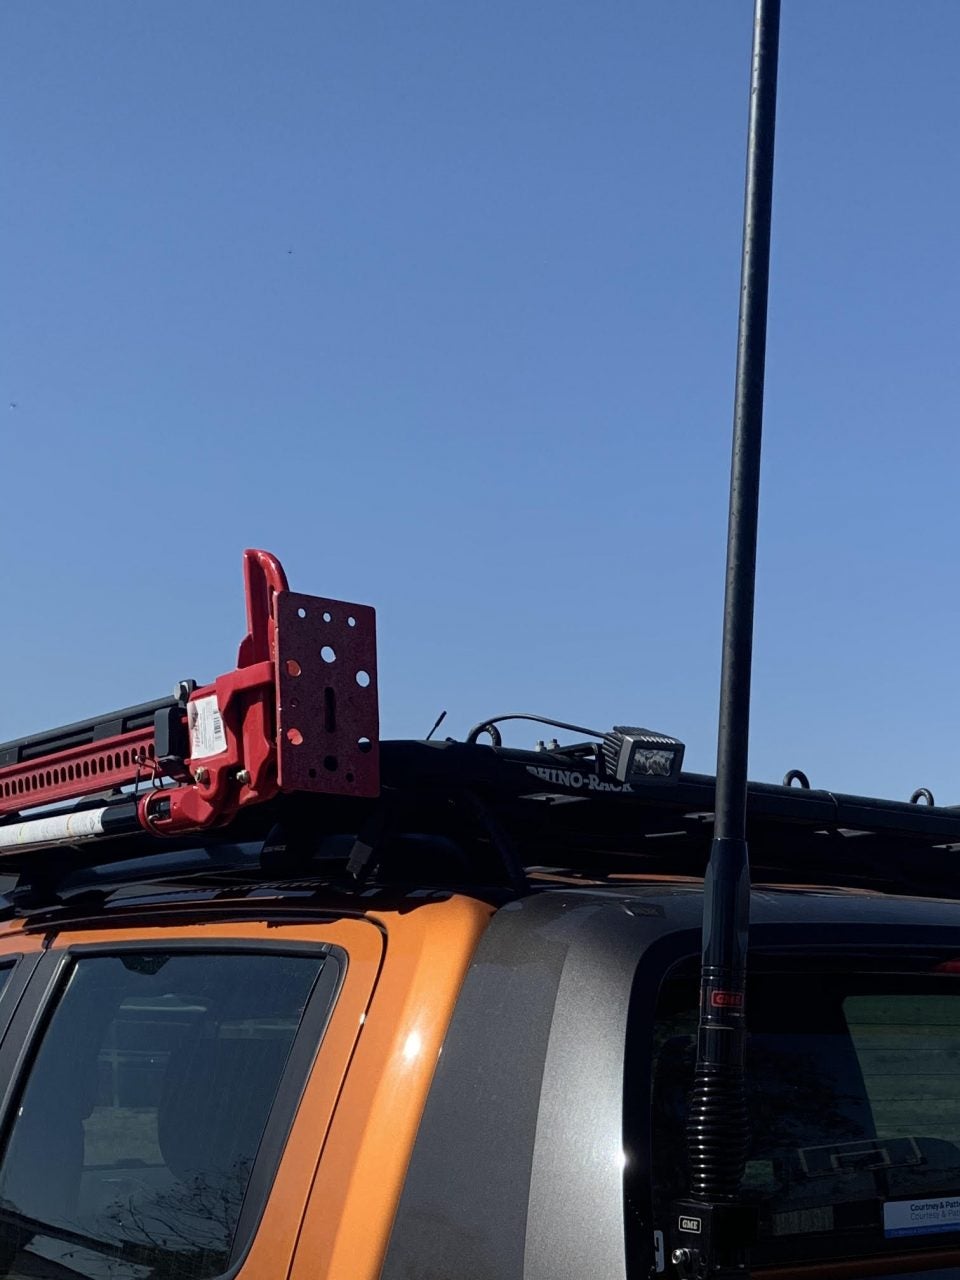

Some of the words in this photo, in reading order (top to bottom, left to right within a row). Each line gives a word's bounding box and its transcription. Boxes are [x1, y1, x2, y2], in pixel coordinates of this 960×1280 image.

[910, 1202, 939, 1212] Courtney
[910, 1211, 940, 1221] Courtesy
[682, 1218, 699, 1230] GME
